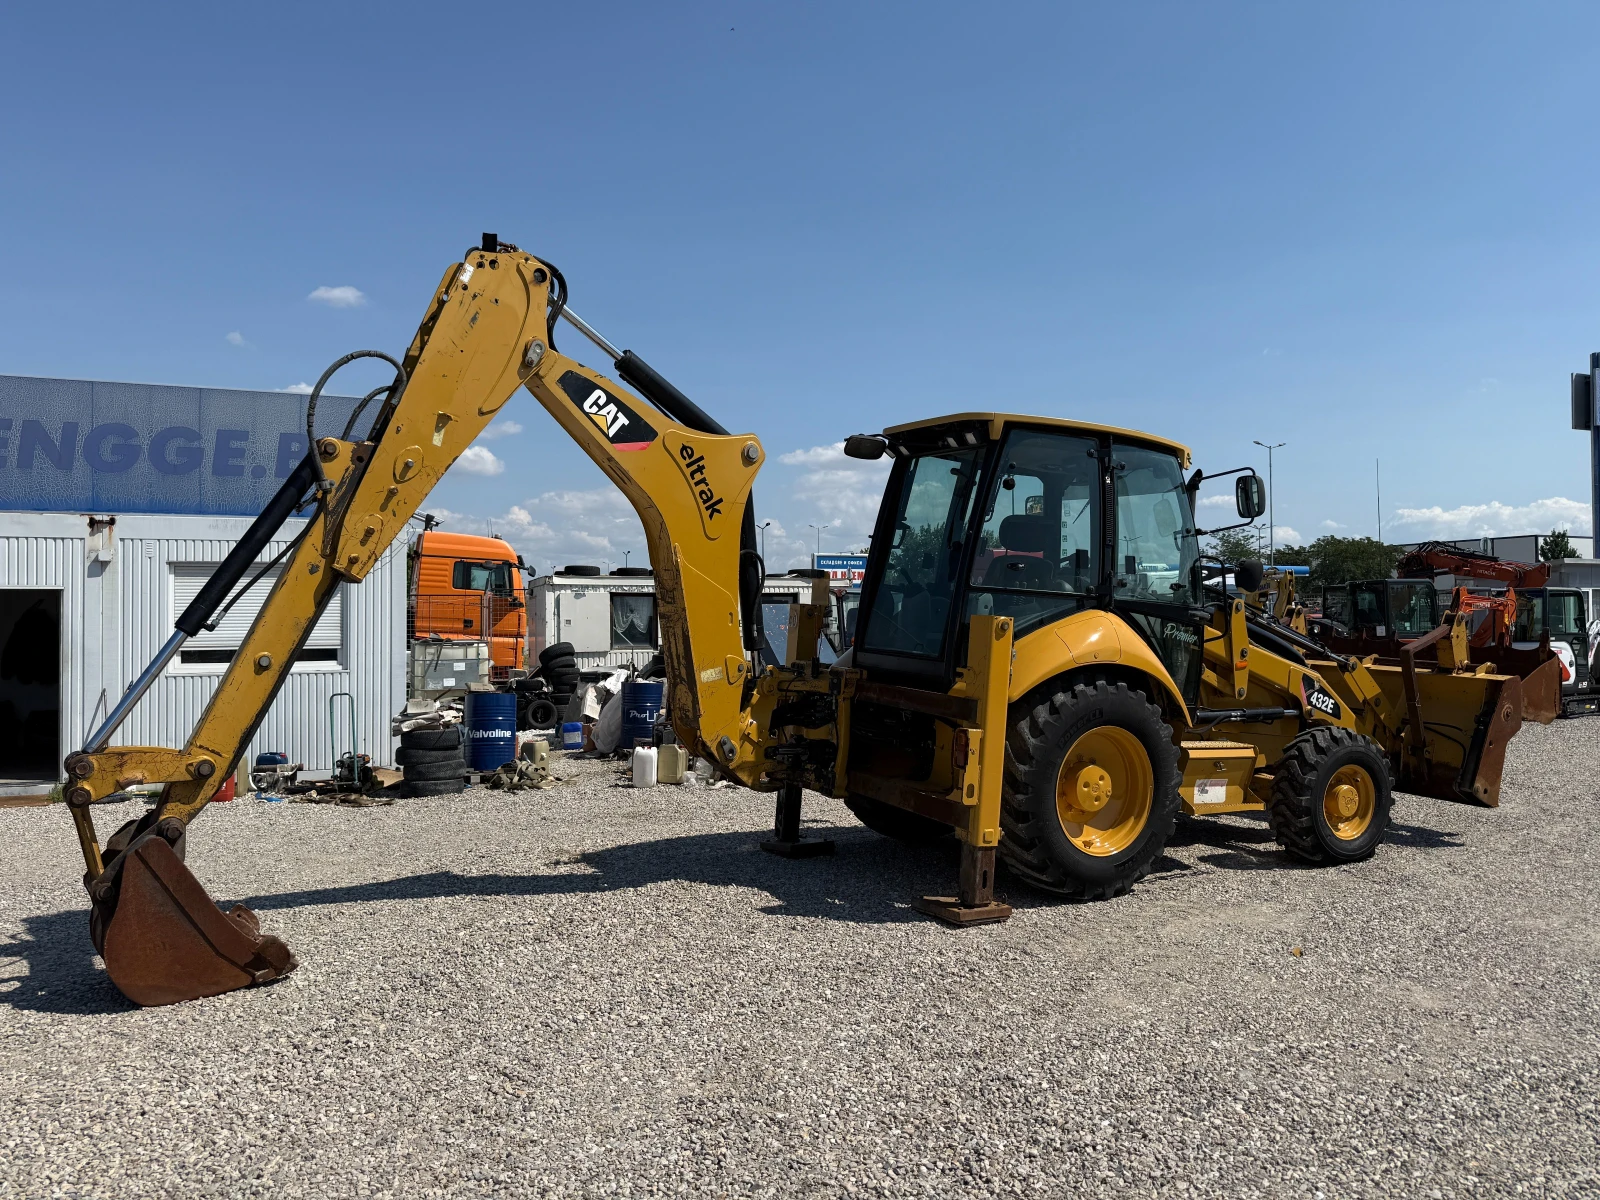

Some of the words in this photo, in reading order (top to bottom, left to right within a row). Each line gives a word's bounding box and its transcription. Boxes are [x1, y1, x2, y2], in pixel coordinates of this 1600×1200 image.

[583, 389, 629, 438] CAT
[679, 443, 723, 521] eltrak
[1163, 622, 1198, 644] Premier
[1310, 691, 1335, 714] 432E
[468, 728, 512, 739] Valvoline
